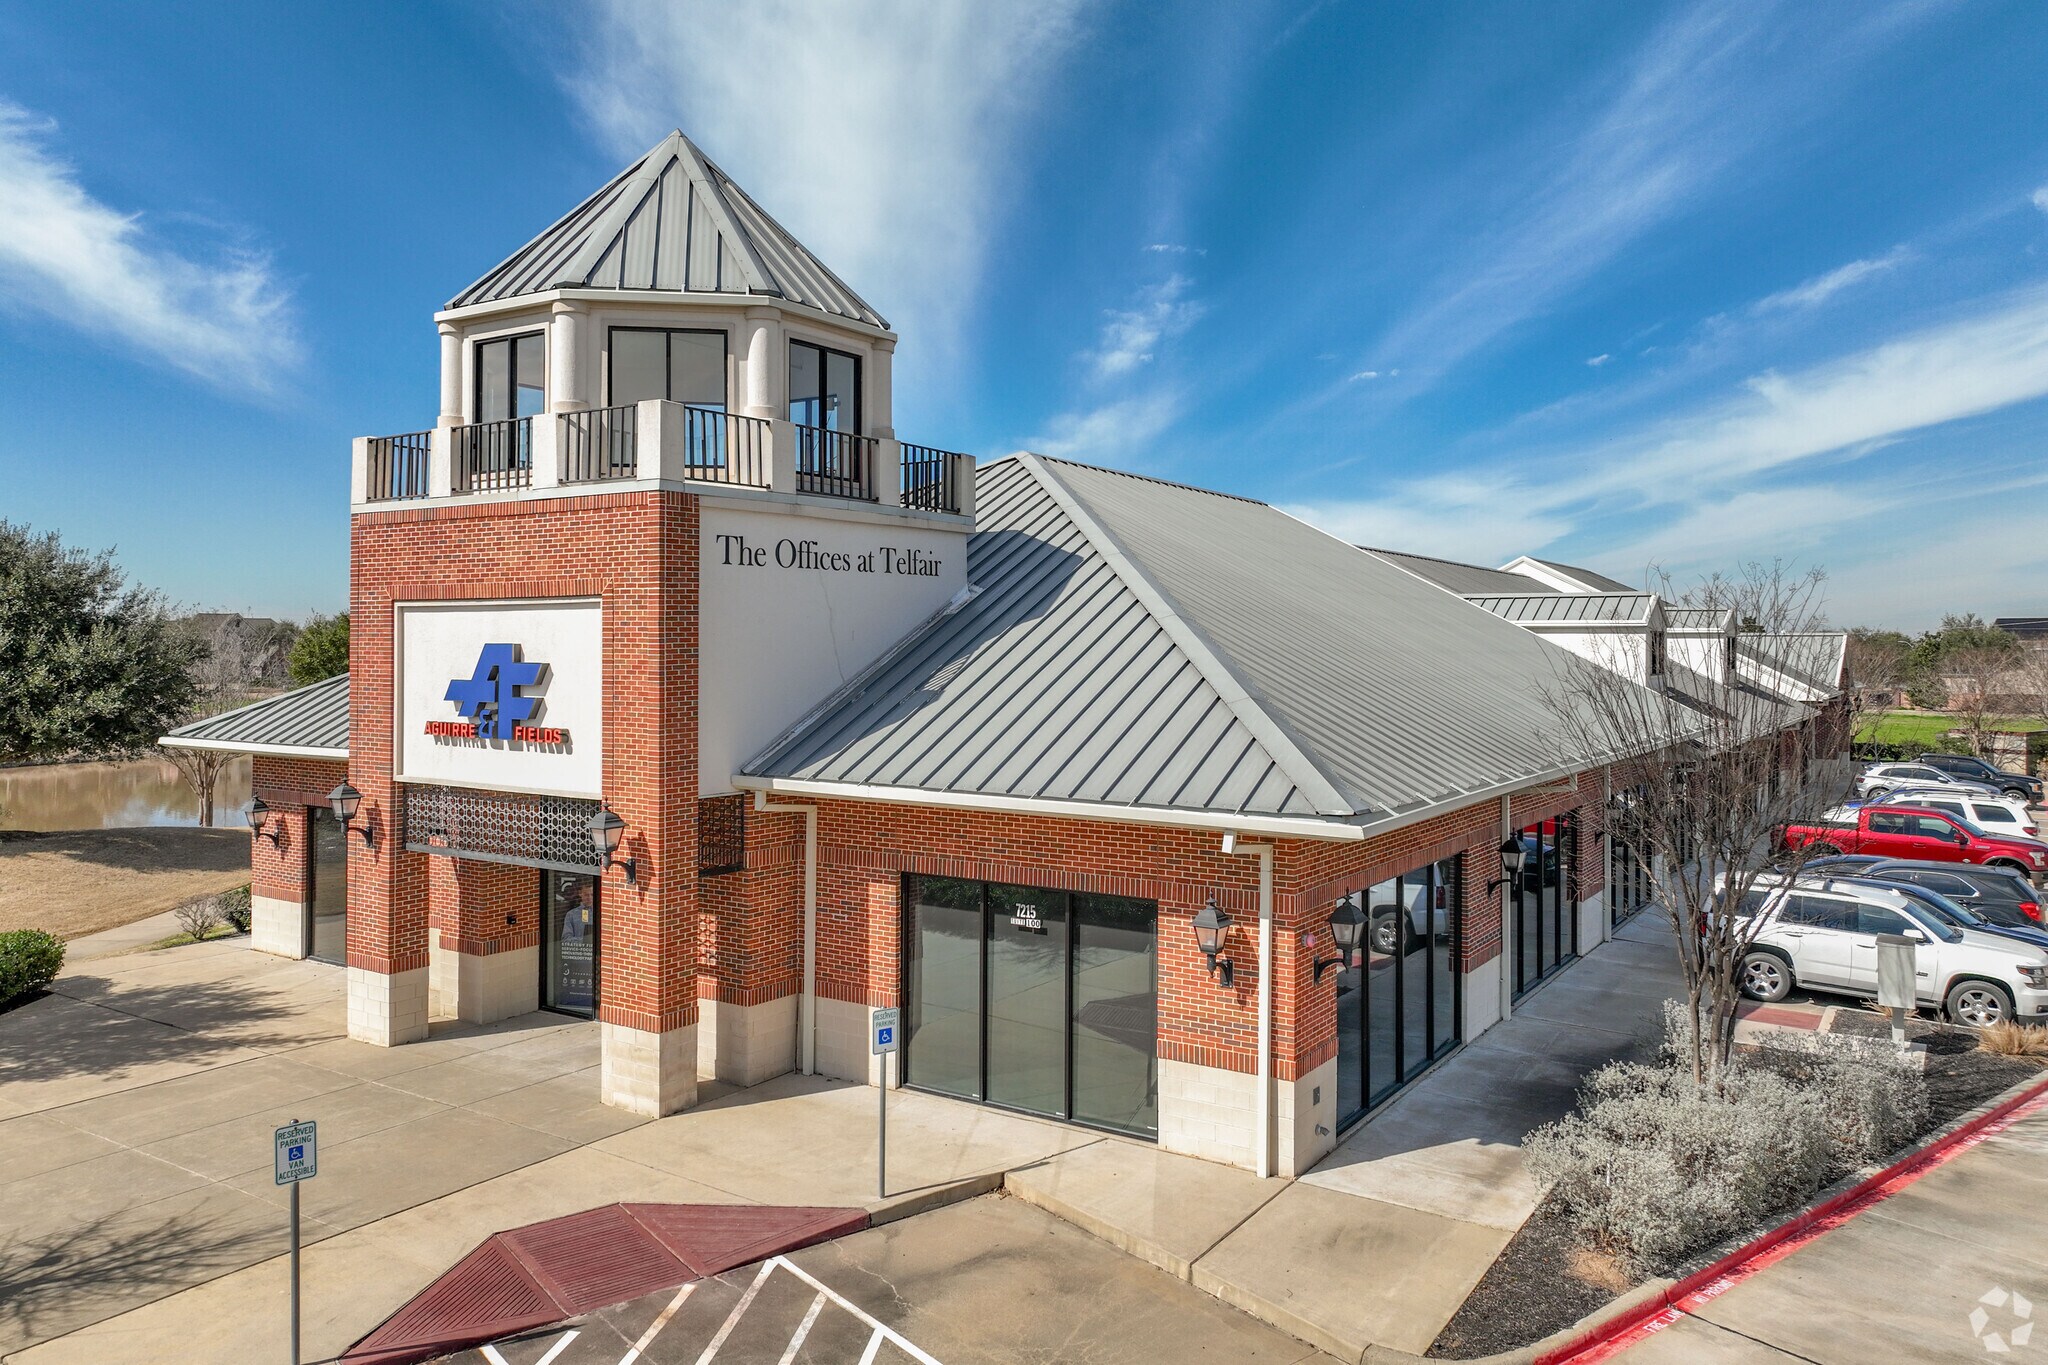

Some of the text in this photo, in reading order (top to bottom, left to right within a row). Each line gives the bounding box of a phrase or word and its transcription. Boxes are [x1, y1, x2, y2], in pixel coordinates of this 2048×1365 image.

[716, 534, 942, 577] The Offices at Telfair
[424, 709, 562, 743] AGUIRRE & FIELDS
[1015, 903, 1036, 918] 7215
[1027, 919, 1040, 928] 100
[874, 1011, 897, 1020] RESERVED
[876, 1019, 895, 1027] PARKING
[278, 1126, 314, 1141] RESERVED
[280, 1135, 312, 1149] PARKING
[289, 1159, 305, 1169] VAN
[279, 1165, 314, 1180] ACCESSIBLE
[1643, 1320, 1669, 1333] FIRE
